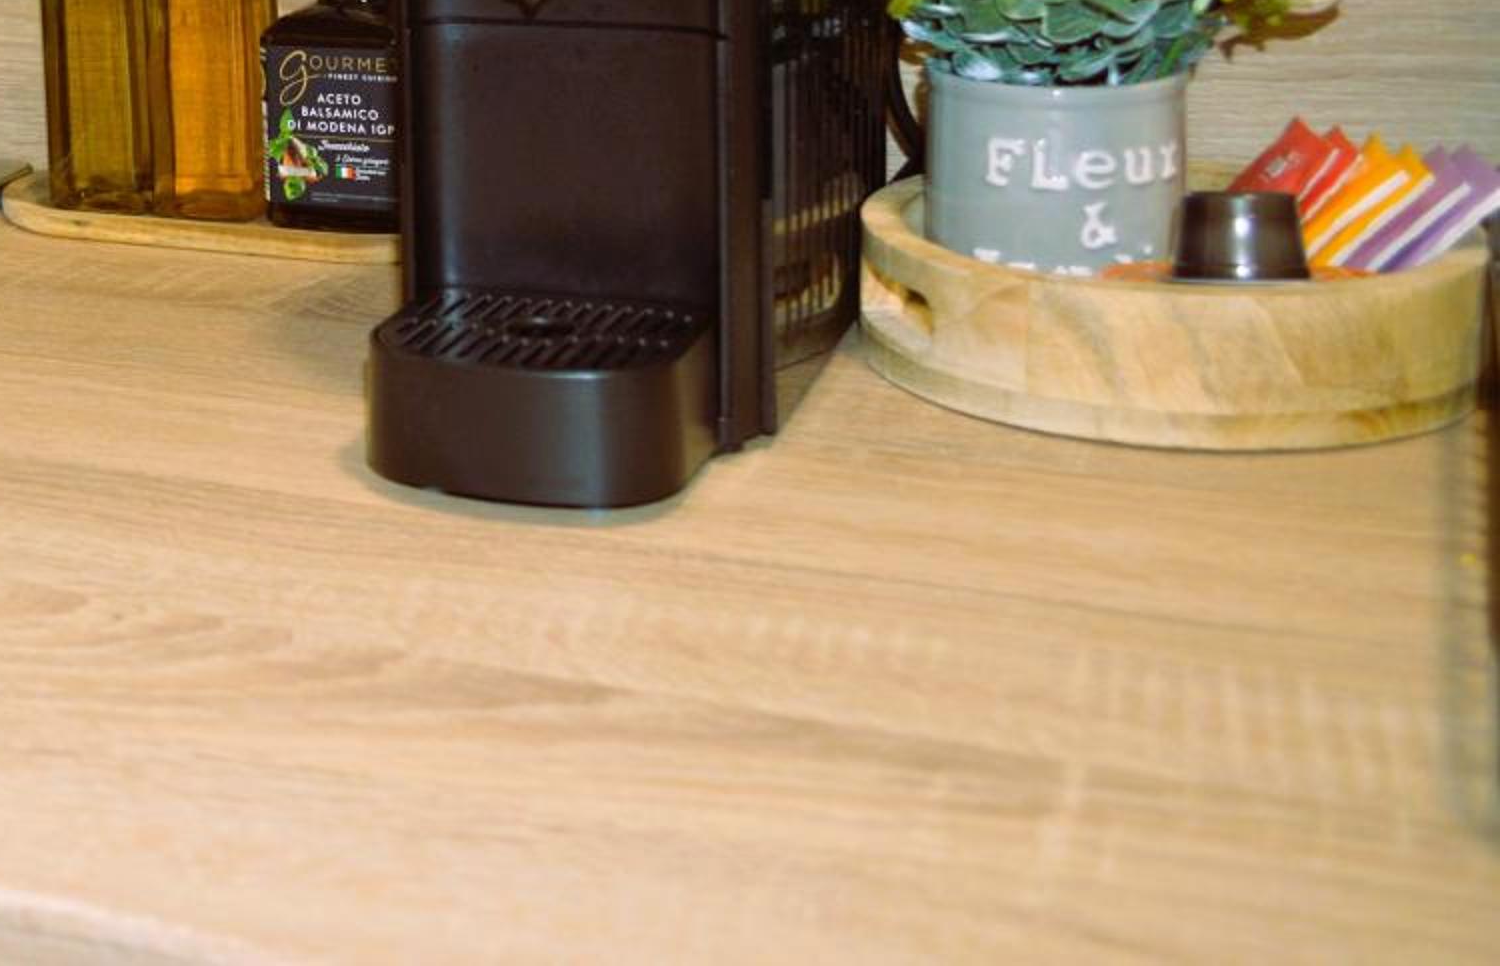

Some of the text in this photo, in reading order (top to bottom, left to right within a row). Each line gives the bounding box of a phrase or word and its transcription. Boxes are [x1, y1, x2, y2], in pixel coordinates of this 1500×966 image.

[279, 49, 389, 106] GOURME
[317, 92, 362, 106] ACETO
[301, 105, 380, 122] BALSAMICO
[287, 119, 395, 136] DI MODENA IGP
[1080, 201, 1118, 250] &
